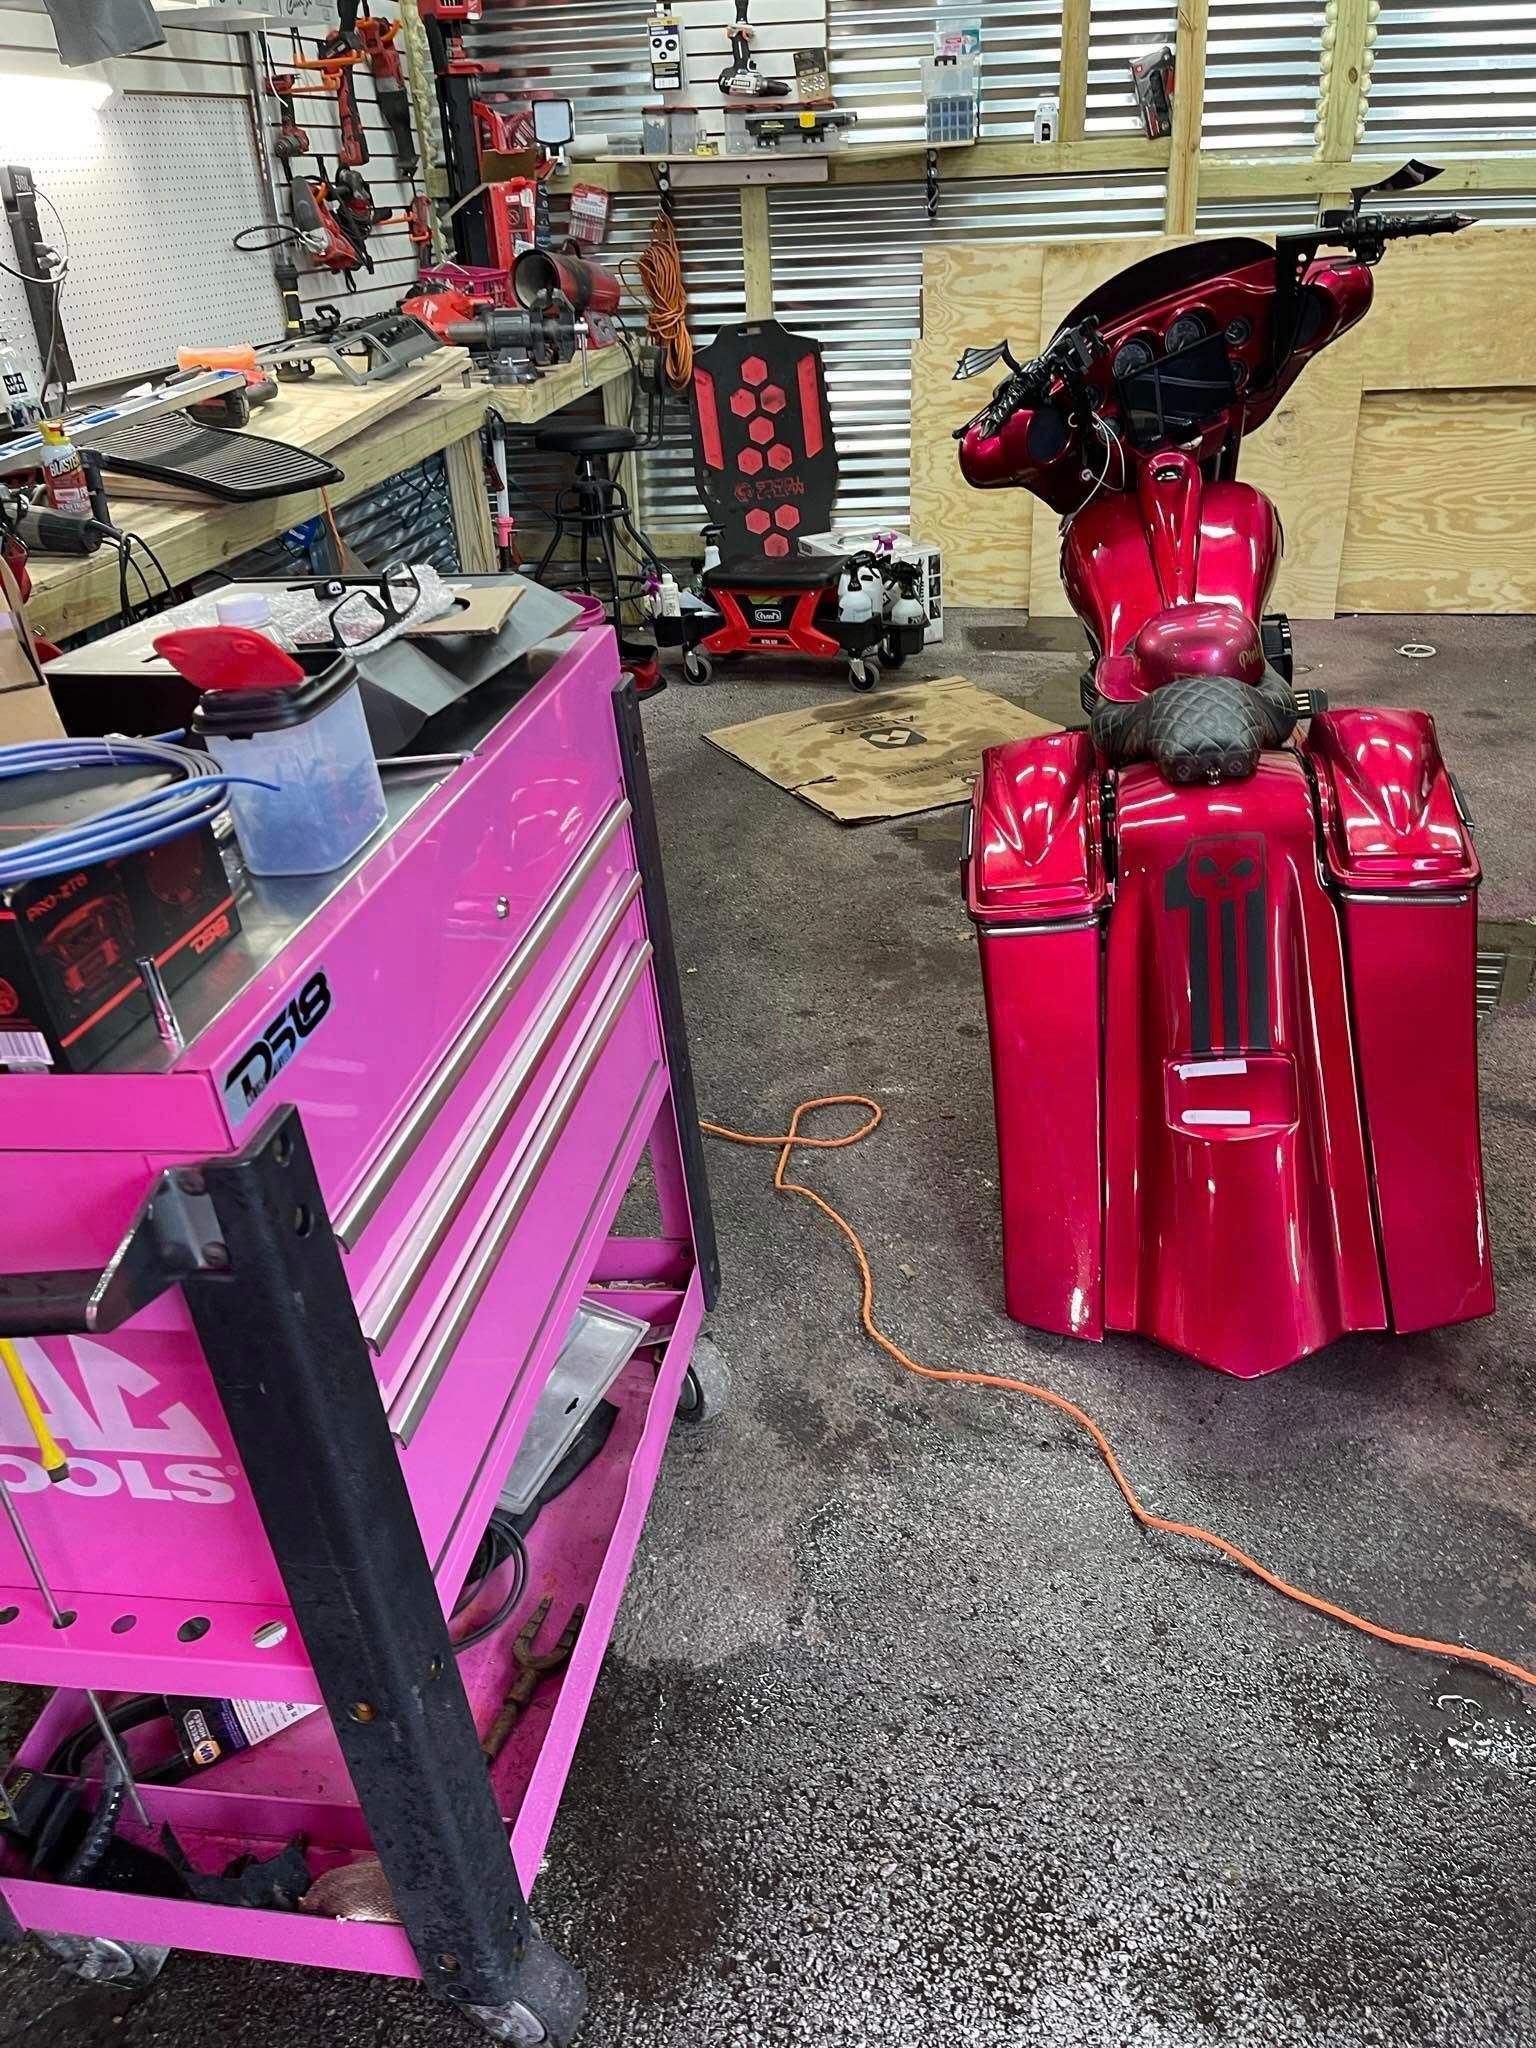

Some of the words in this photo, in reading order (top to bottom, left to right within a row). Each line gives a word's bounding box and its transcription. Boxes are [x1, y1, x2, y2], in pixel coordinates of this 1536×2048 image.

[4, 375, 24, 385] LIFE
[826, 714, 915, 735] ALCOA
[224, 971, 331, 1107] DS18
[0, 1335, 222, 1458] AC
[0, 1454, 237, 1504] OOLS
